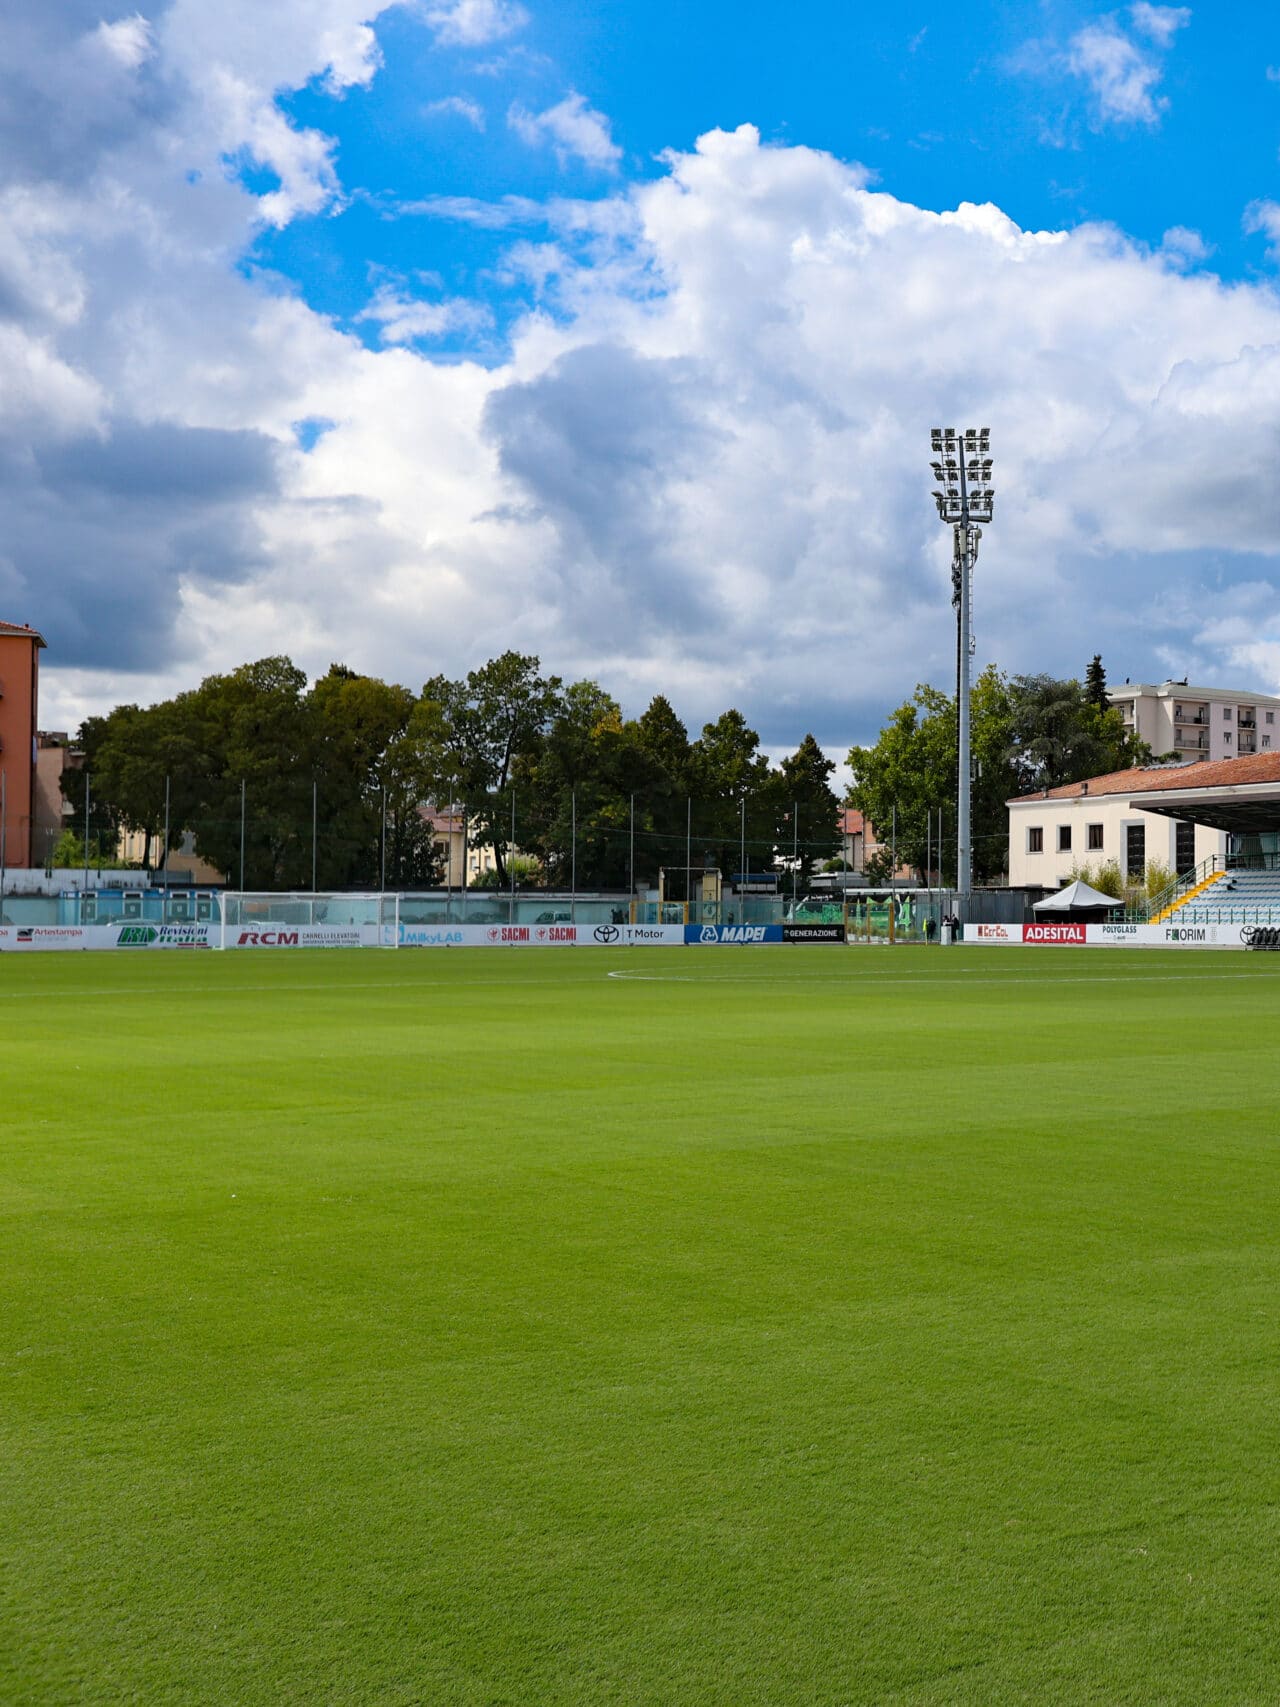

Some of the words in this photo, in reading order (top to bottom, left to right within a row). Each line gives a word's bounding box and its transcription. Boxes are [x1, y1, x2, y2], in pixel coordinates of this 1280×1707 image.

[34, 928, 82, 937] Artestampa
[501, 928, 529, 941] SACMI
[549, 928, 577, 941] SACMI
[635, 929, 664, 938] Motor
[720, 927, 766, 942] MAPEI
[789, 929, 838, 937] GENERAZIONE
[1026, 928, 1083, 940] ADESITAL
[1103, 926, 1137, 934] POLYGLASS
[237, 932, 299, 945] RCM
[407, 932, 463, 944] MilkyLAB
